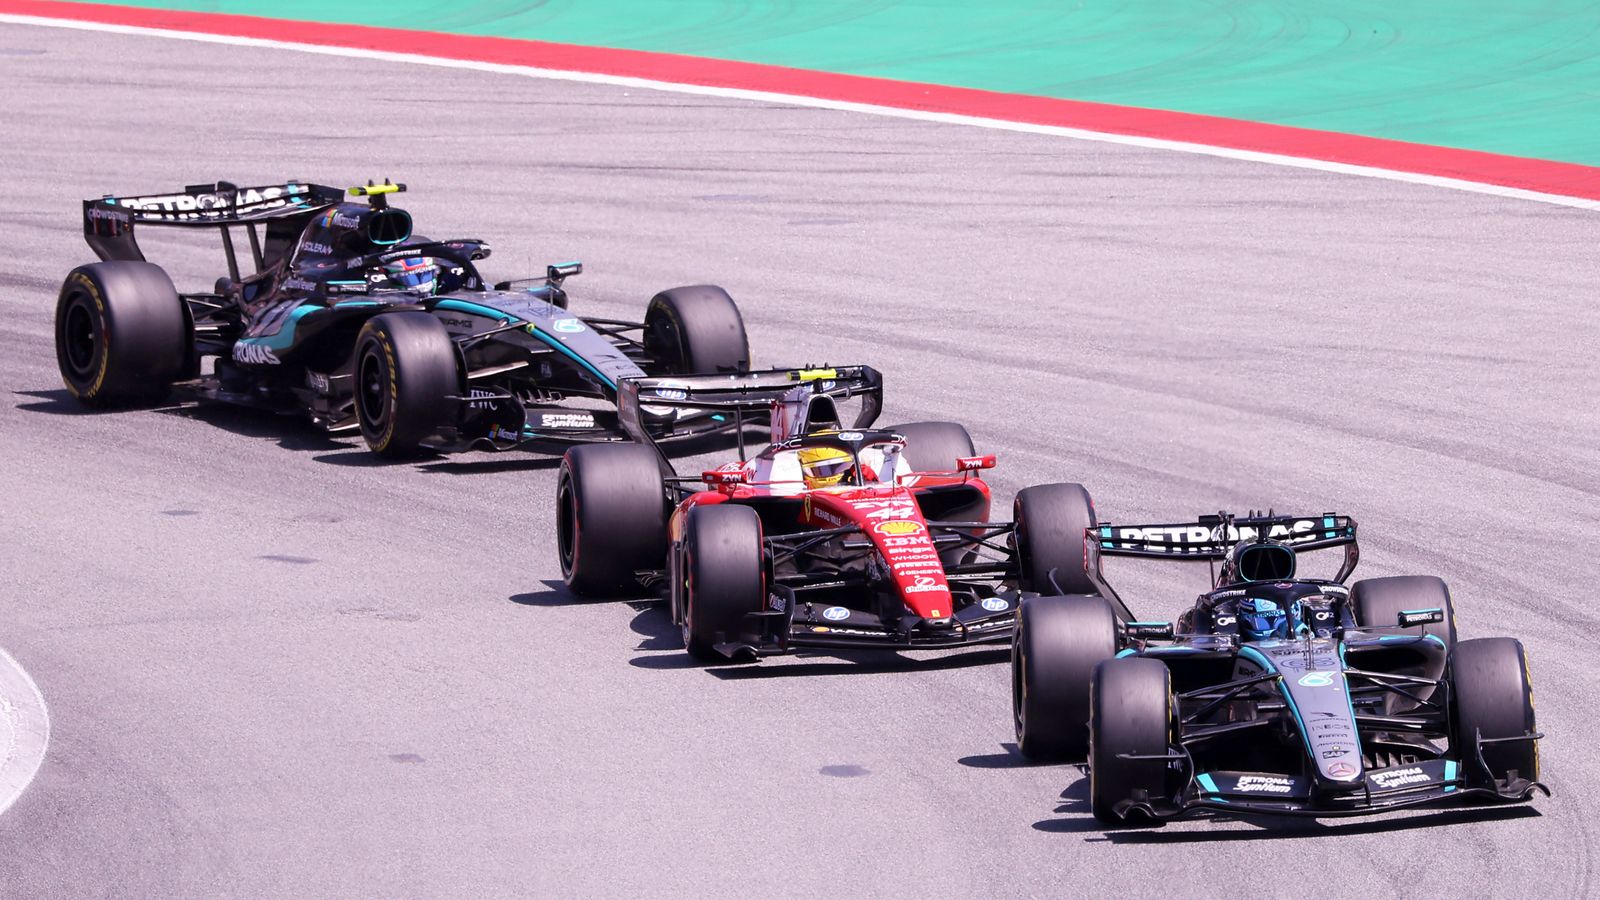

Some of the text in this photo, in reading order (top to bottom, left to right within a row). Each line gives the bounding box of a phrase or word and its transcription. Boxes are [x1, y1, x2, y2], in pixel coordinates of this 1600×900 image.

[121, 187, 285, 218] PETRONAS
[541, 414, 594, 422] PETRONAS
[541, 419, 594, 428] Syntium
[964, 460, 982, 468] ZYN
[721, 474, 742, 482] ZYN
[866, 507, 914, 519] 44
[1119, 519, 1317, 552] PETRONAS
[883, 536, 930, 547] IBM
[985, 599, 1006, 610] hp
[826, 608, 848, 619] hp
[1323, 751, 1347, 759] SAP
[1370, 767, 1423, 781] PETRONAS
[1239, 775, 1295, 786] PETRONAS
[1378, 773, 1430, 788] Syntium
[1233, 783, 1291, 793] Syntium
